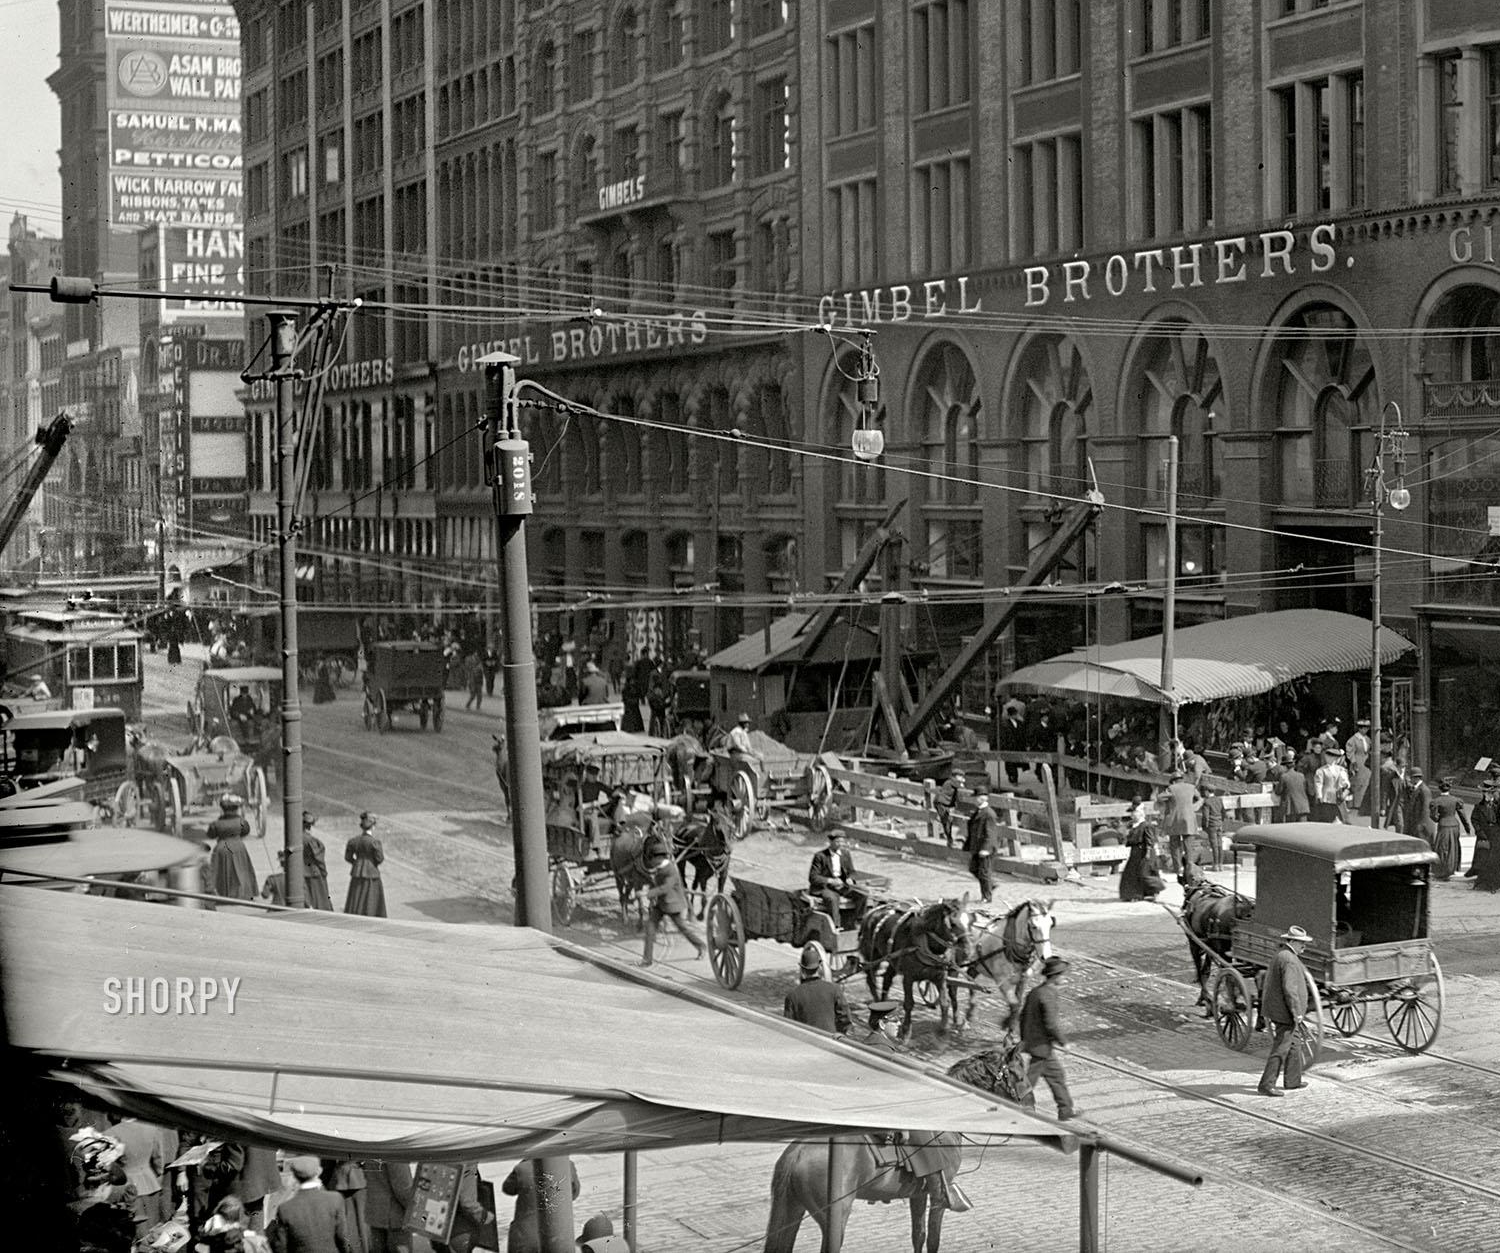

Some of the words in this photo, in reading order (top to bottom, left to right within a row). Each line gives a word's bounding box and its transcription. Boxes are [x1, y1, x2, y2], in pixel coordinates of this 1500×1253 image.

[109, 9, 199, 37] WERTHEIMER
[169, 76, 211, 98] WALL
[116, 113, 190, 131] SAMUEL
[114, 176, 150, 194] WICK
[153, 177, 216, 196] NARROW
[599, 174, 646, 211] GIMBELS
[171, 262, 226, 285] FINE
[818, 276, 982, 329] GIMBEL
[1023, 223, 1355, 308] BROTHERS.
[551, 311, 708, 363] BROTHERS
